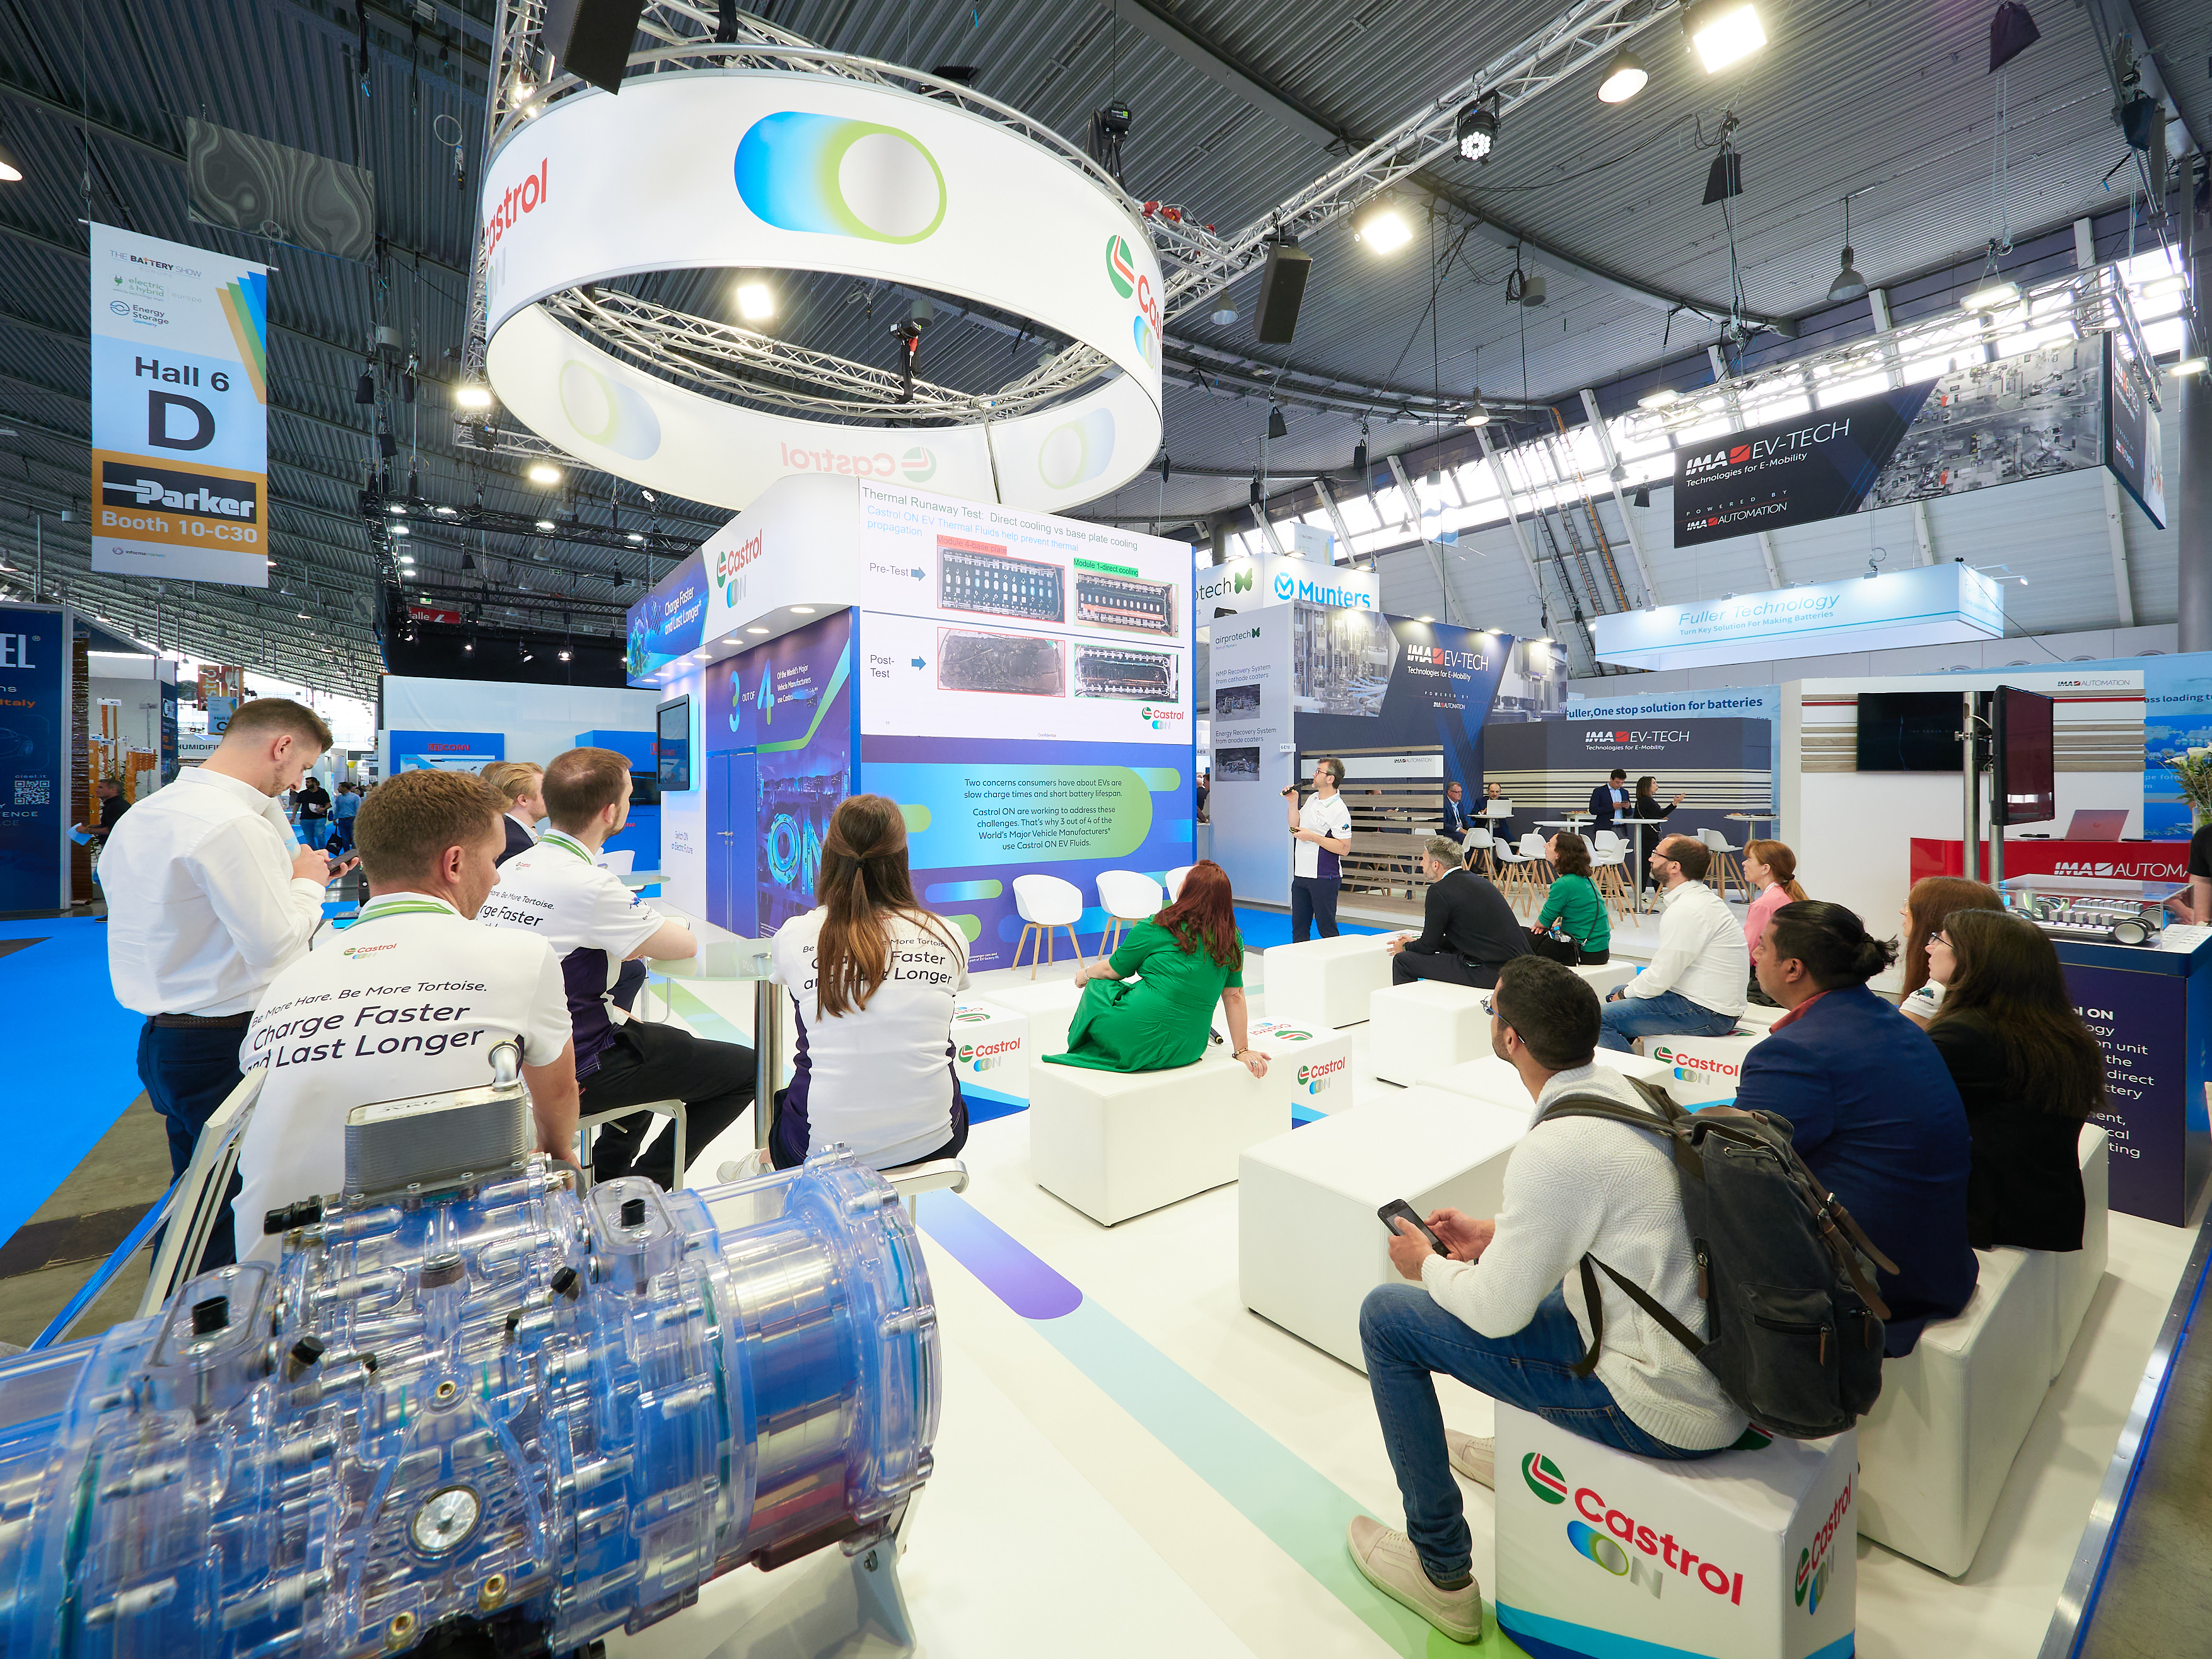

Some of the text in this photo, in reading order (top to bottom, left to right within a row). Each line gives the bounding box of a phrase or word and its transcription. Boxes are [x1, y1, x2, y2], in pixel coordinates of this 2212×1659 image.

[110, 250, 201, 277] THE BATTERY SHOW
[129, 277, 164, 290] electric
[136, 285, 164, 297] hybrid
[133, 305, 165, 318] Energy
[133, 311, 169, 324] Storage
[136, 356, 230, 392] Hall 6
[148, 390, 216, 451] D
[1685, 418, 1851, 476] IMA EV-TECH
[1686, 452, 1808, 487] Technologies for E-Mobility
[136, 479, 254, 518] Parker
[1686, 489, 1787, 516] POWERED BY
[862, 487, 1138, 551] Thermal Runaway Test: Direct cooling vs base plate cooling
[1687, 502, 1788, 531] IMA AUTOMATION
[102, 510, 257, 543] Booth 10-C30
[868, 505, 1078, 552] Castrol ON EV Thermal Fluids help prevent thermal
[868, 521, 923, 537] propagation
[728, 528, 762, 576] Castrol
[937, 536, 1007, 555] Module 4-base plate
[870, 562, 909, 576] Pre-Test
[1074, 559, 1138, 578] Module 1-direct cooling
[665, 586, 694, 616] Charge Faster
[1299, 579, 1370, 608] Munters
[1679, 595, 1840, 626] Fuller Technology
[665, 617, 673, 635] and
[673, 613, 682, 630] Last
[1713, 622, 1745, 632] Solution
[1762, 616, 1792, 626] Making
[1795, 611, 1834, 622] Batteries
[1216, 631, 1251, 644] airprotech
[870, 655, 895, 665] Post-
[1407, 644, 1489, 672] IMA EV-TECH
[870, 668, 890, 678] Test
[1228, 667, 1250, 675] Recovery
[1252, 663, 1271, 672] System
[1249, 672, 1269, 680] coaters
[1407, 666, 1439, 677] Technologies
[1448, 671, 1471, 682] E-Mobility
[729, 670, 740, 732] 3
[750, 691, 755, 700] OF
[757, 658, 775, 725] 4
[2163, 694, 2204, 702] loading
[1153, 710, 1184, 720] Castrol
[1615, 697, 1763, 716] stop solution for batteries
[1257, 727, 1276, 735] System
[1585, 731, 1690, 743] IMA EV-TECH
[984, 791, 1010, 800] charge
[1069, 789, 1094, 799] battery
[1095, 789, 1122, 798] lifespan.
[973, 808, 1001, 816] Castrol
[1031, 807, 1059, 816] working
[1069, 806, 1097, 814] address
[977, 819, 1020, 829] challenges.
[1045, 818, 1059, 827] why
[979, 831, 1008, 839] World's
[1010, 830, 1031, 840] Major
[1032, 829, 1057, 837] Vehicle
[1017, 841, 1043, 849] Castrol
[2054, 862, 2093, 875] IMA
[508, 893, 554, 910] More Tortoise.
[498, 906, 544, 926] Faster
[357, 943, 397, 953] Castrol
[892, 951, 946, 965] Faster
[895, 967, 952, 984] Longer
[252, 980, 487, 1028] Be More Hare. Be More Tortoise.
[2087, 1008, 2114, 1020] ON
[254, 1003, 470, 1051] Charge Faster
[276, 1029, 484, 1068] Last Longer
[975, 1038, 1020, 1057] Castrol
[2117, 1042, 2149, 1056] unit
[1311, 1056, 1346, 1078] Castrol
[1676, 1053, 1738, 1076] Castrol
[2105, 1054, 2133, 1067] the
[2107, 1069, 2155, 1086] direct
[1812, 1472, 1851, 1571] Castrol
[1575, 1487, 1743, 1606] Castrol
[1567, 1520, 1663, 1600] ON
